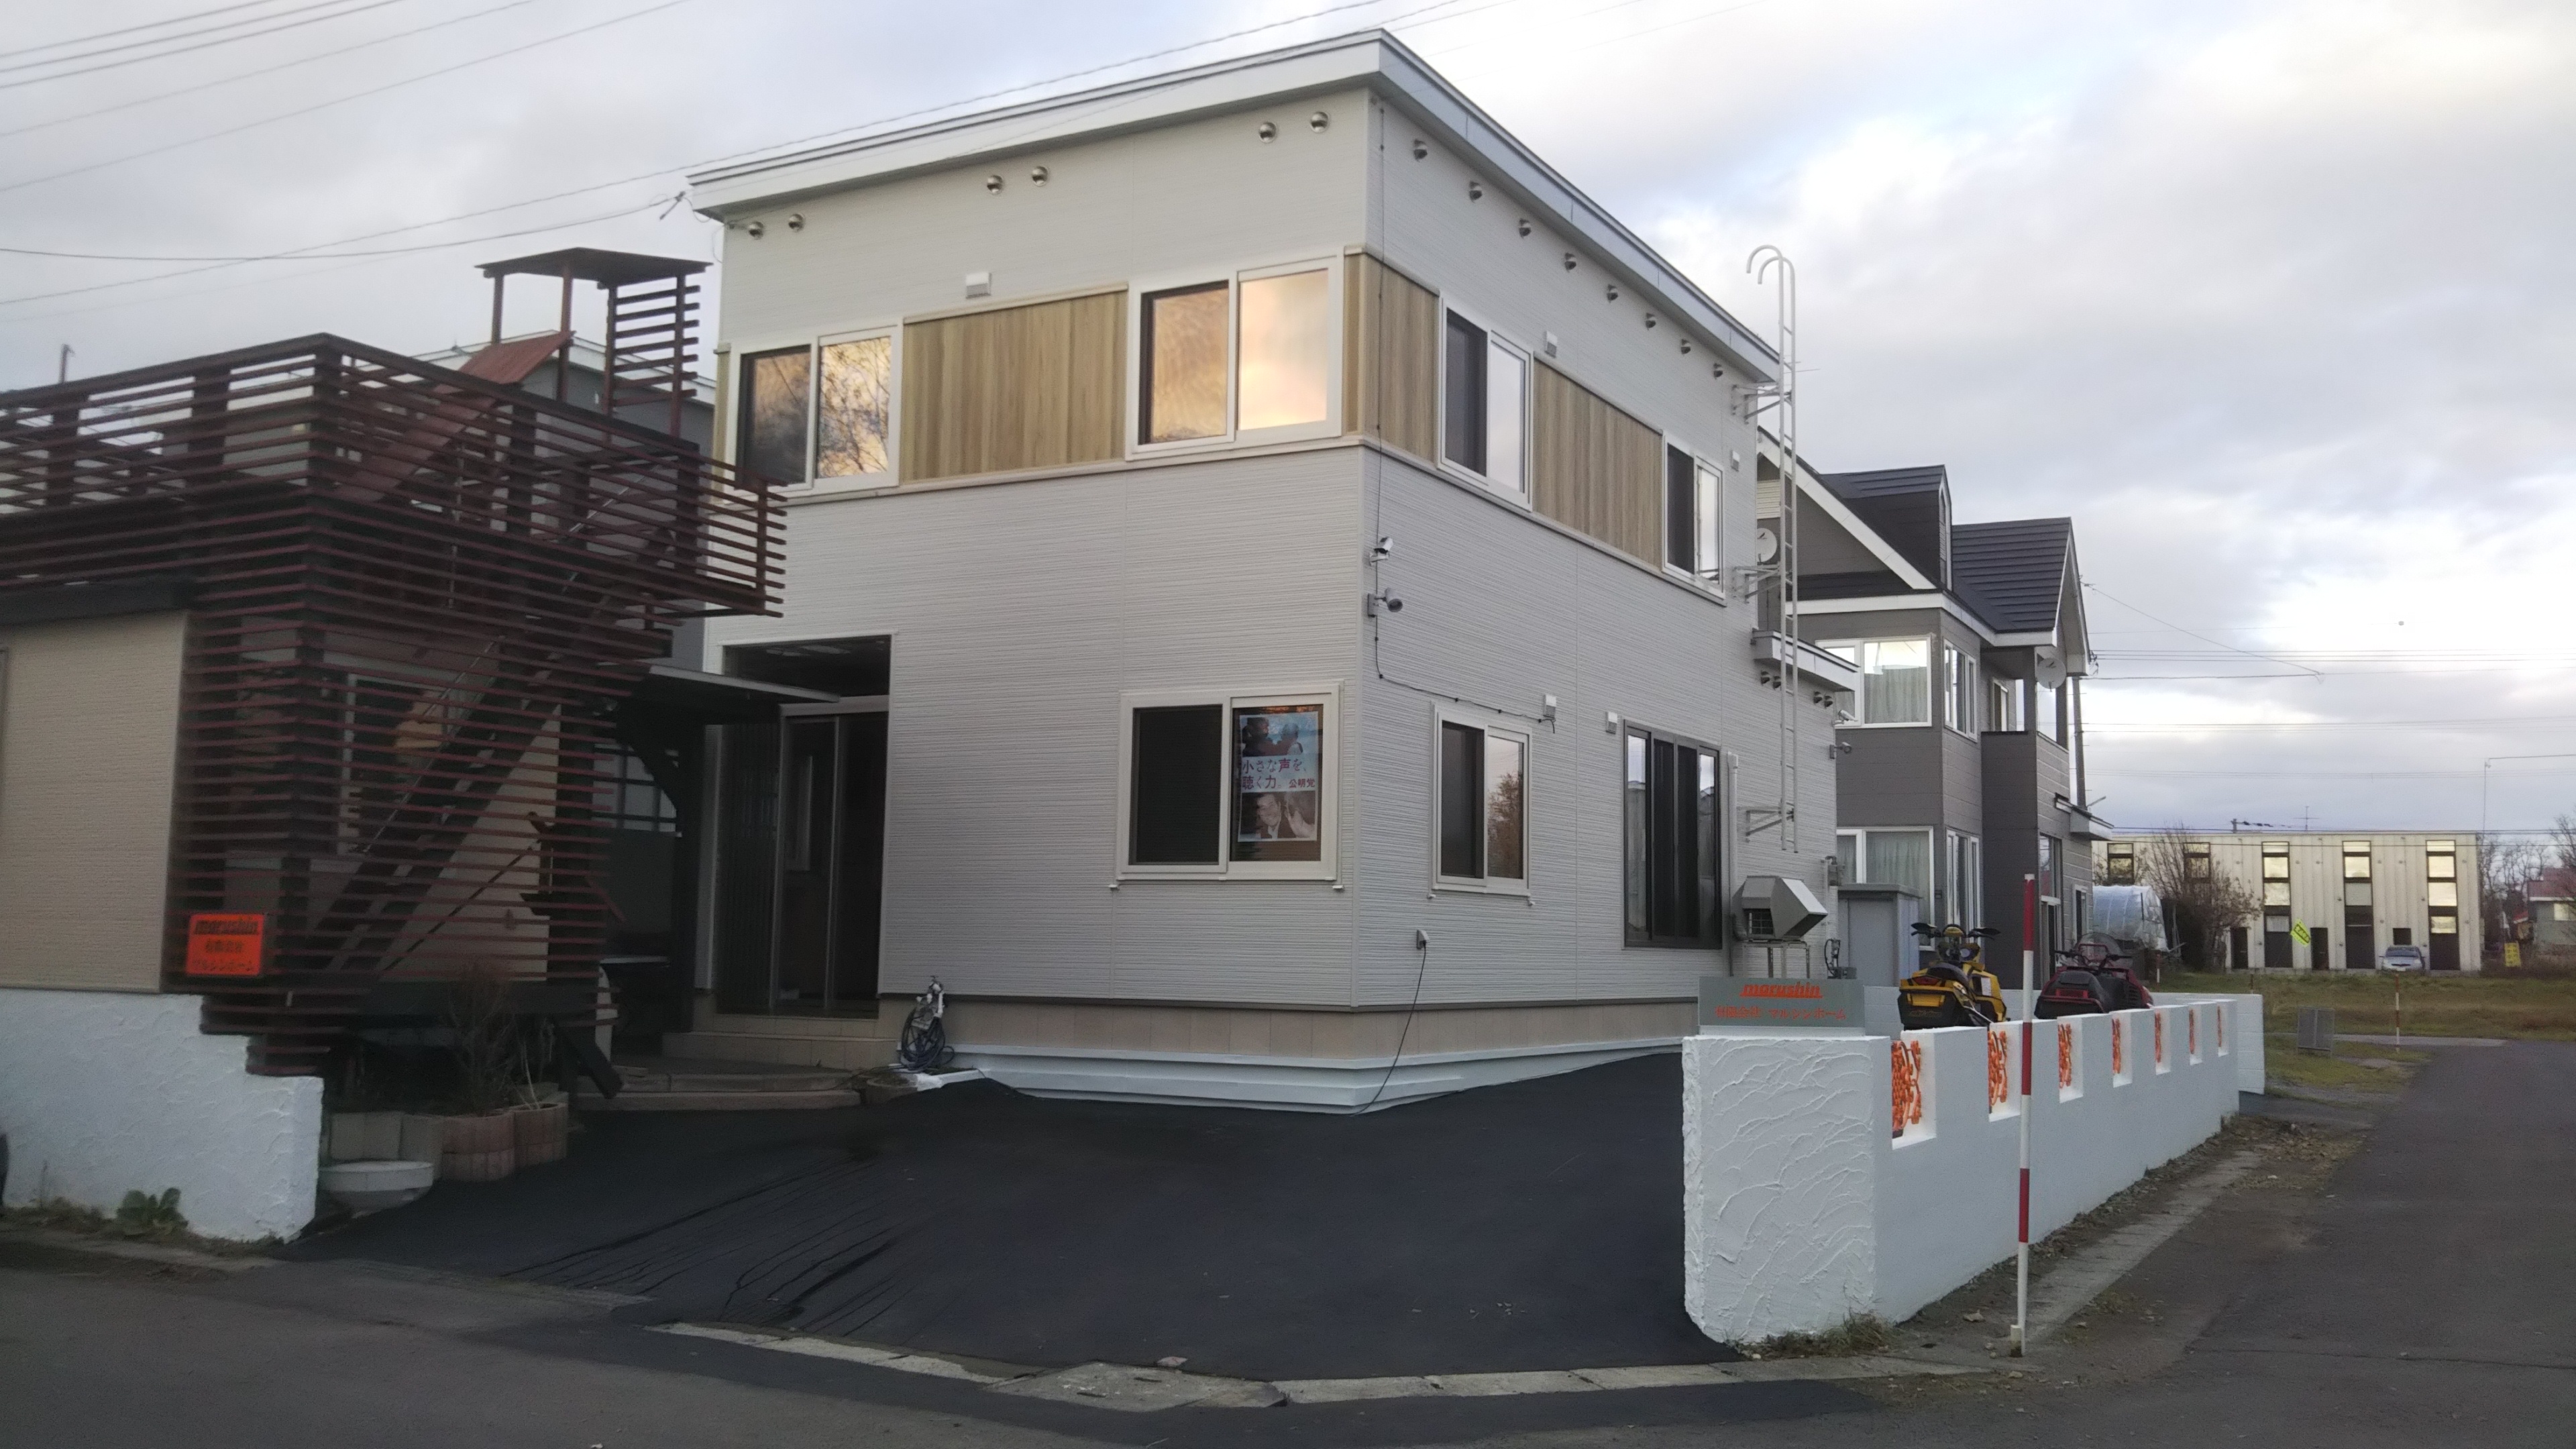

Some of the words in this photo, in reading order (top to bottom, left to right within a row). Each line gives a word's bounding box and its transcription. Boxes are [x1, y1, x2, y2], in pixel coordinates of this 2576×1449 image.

[1242, 758, 1307, 774] 小さな声を、
[1289, 778, 1316, 789] 公明党
[1768, 1008, 1846, 1020] マルシンホーム
